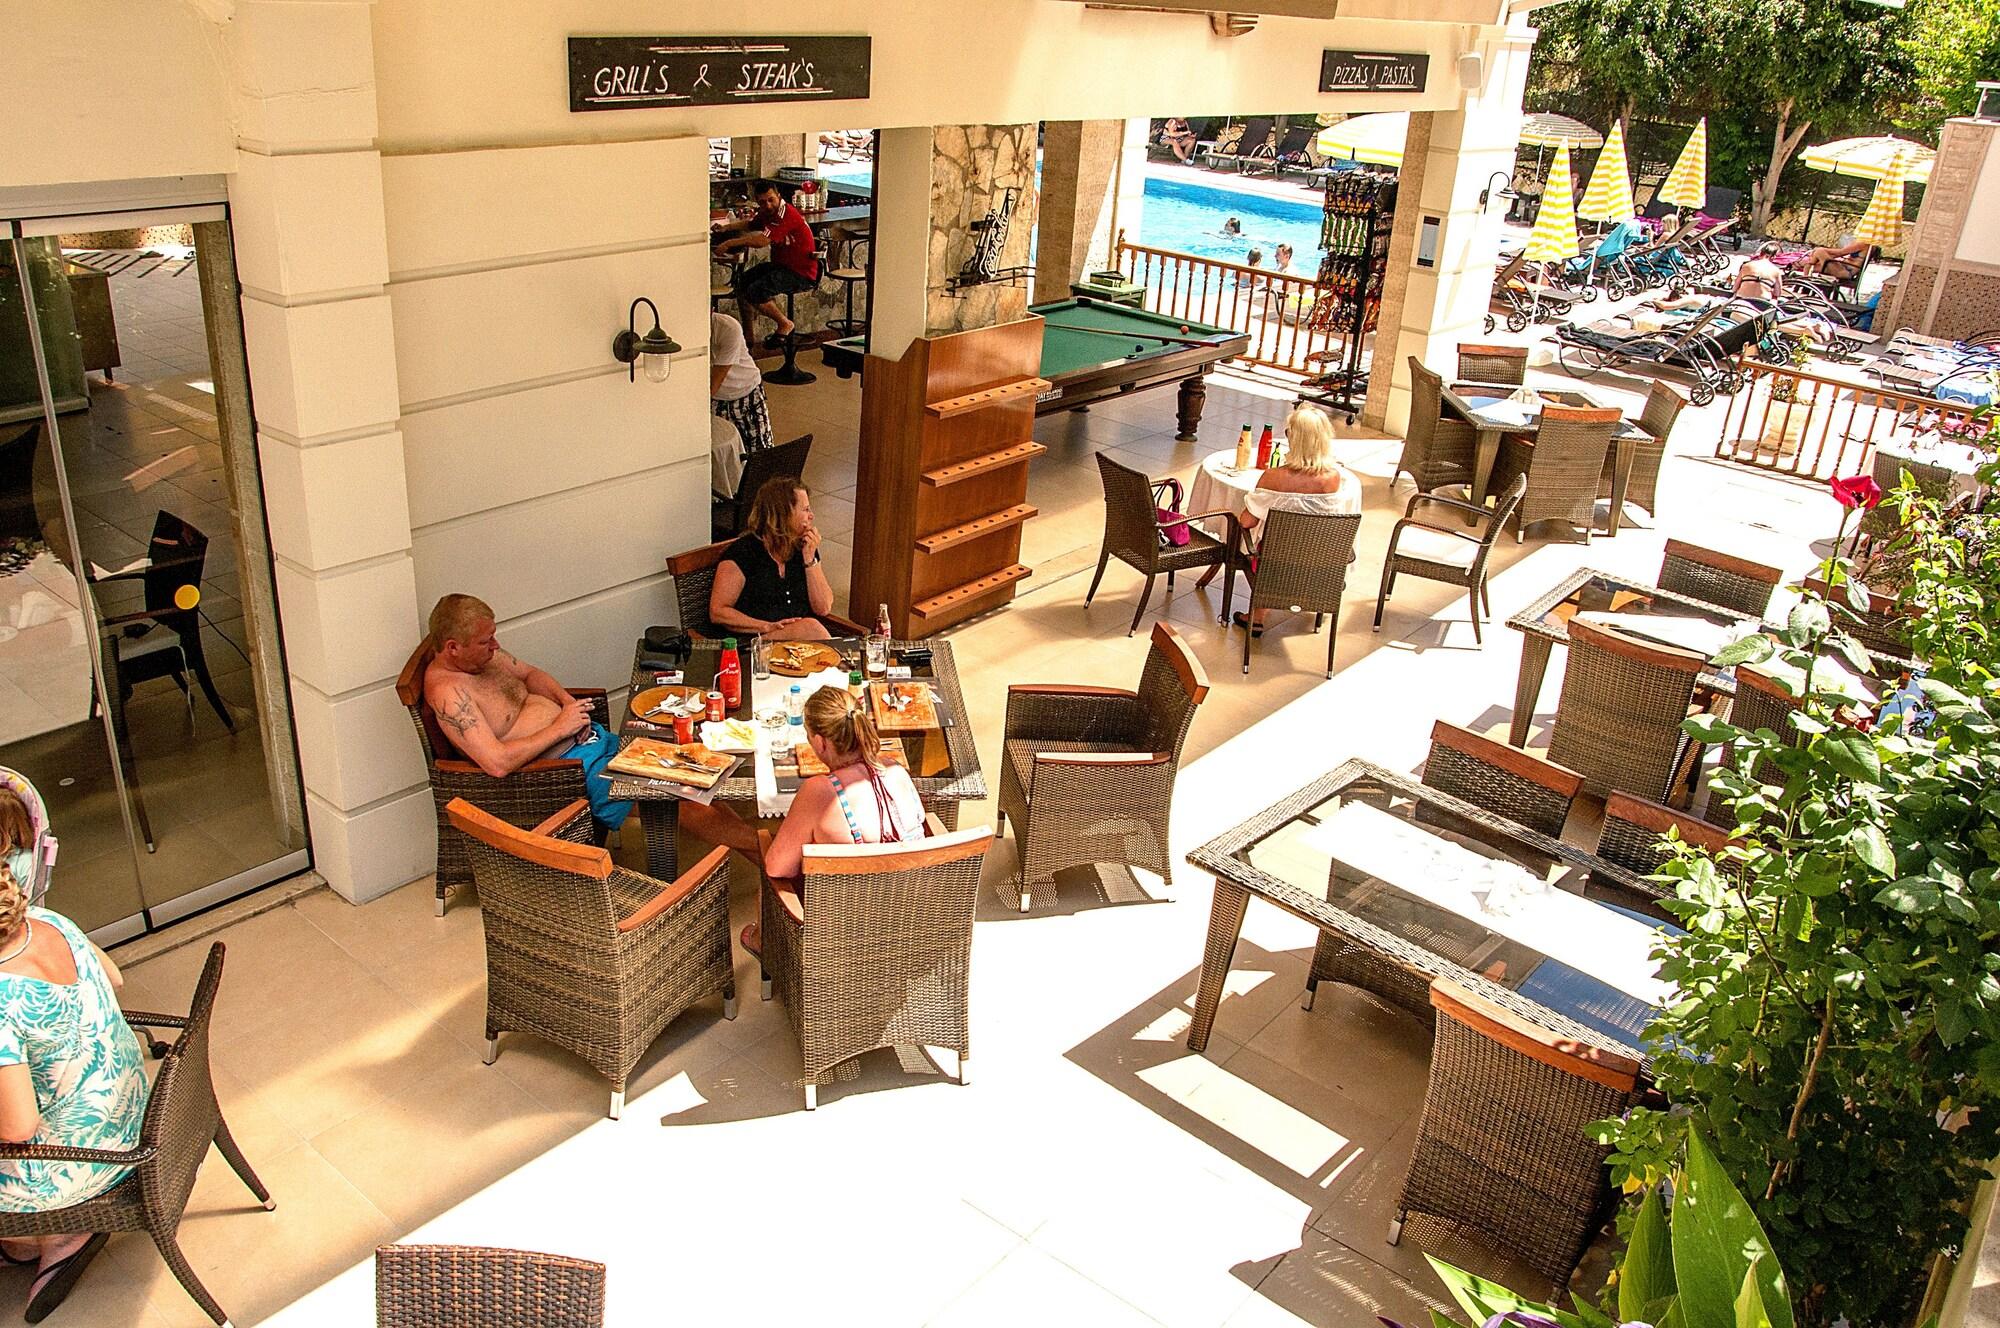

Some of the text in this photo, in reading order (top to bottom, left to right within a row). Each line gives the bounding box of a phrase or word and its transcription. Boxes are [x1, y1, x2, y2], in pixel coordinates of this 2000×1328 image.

[594, 57, 815, 96] GRILL'S & STEAK'S
[1380, 64, 1415, 85] PASTA'S
